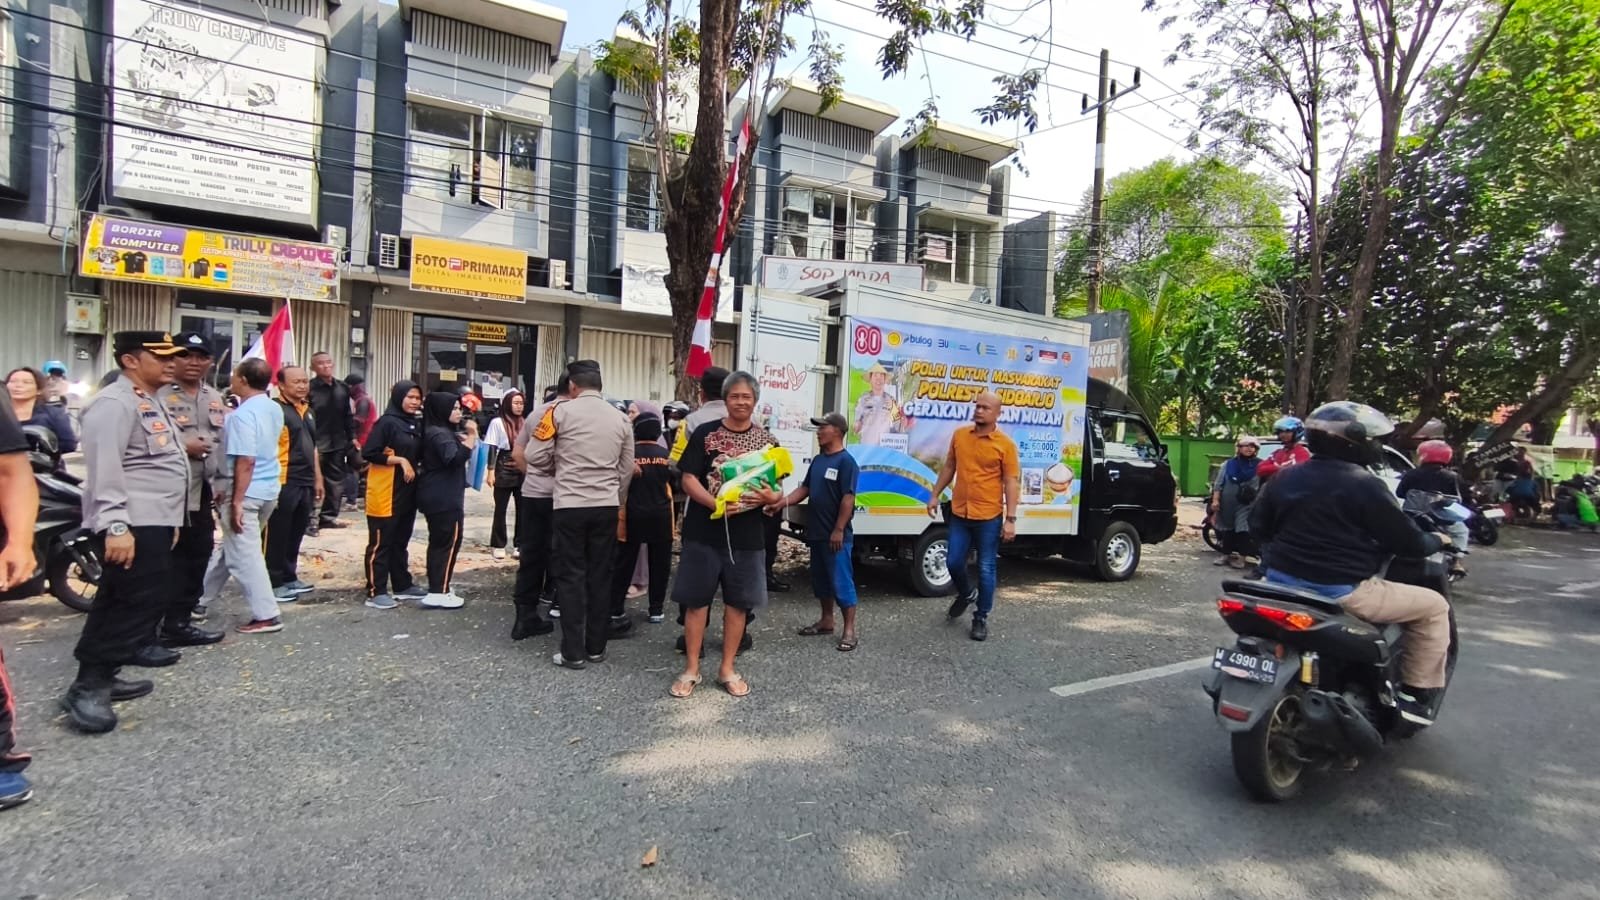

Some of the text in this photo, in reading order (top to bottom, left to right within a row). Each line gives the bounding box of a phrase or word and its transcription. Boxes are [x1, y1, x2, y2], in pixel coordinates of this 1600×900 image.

[151, 6, 286, 52] TRULY CREATIVE
[131, 143, 178, 157] FOTO CANVAS
[191, 153, 238, 167] TOPI CUSTOM
[246, 163, 271, 172] POSTER
[279, 168, 298, 177] DECAL
[111, 224, 162, 238] BORDIR
[110, 237, 180, 253] KOMPUTER
[223, 236, 266, 254] TRULY
[415, 253, 447, 268] FOTO
[462, 260, 524, 279] PRIMAMAX
[800, 265, 835, 281] SOP
[416, 267, 523, 286] DIGITAL IMAGE SERVICE
[854, 324, 882, 356] 80
[909, 334, 932, 347] bulog
[764, 364, 786, 379] First
[911, 360, 1062, 389] POLRI UNTUK MASYARAKAT
[758, 376, 790, 390] Friend
[917, 380, 988, 403] POLREST
[903, 401, 970, 422] GERAKAN
[1020, 409, 1063, 427] MURAH
[1216, 649, 1224, 660] W
[1229, 652, 1256, 668] 4990
